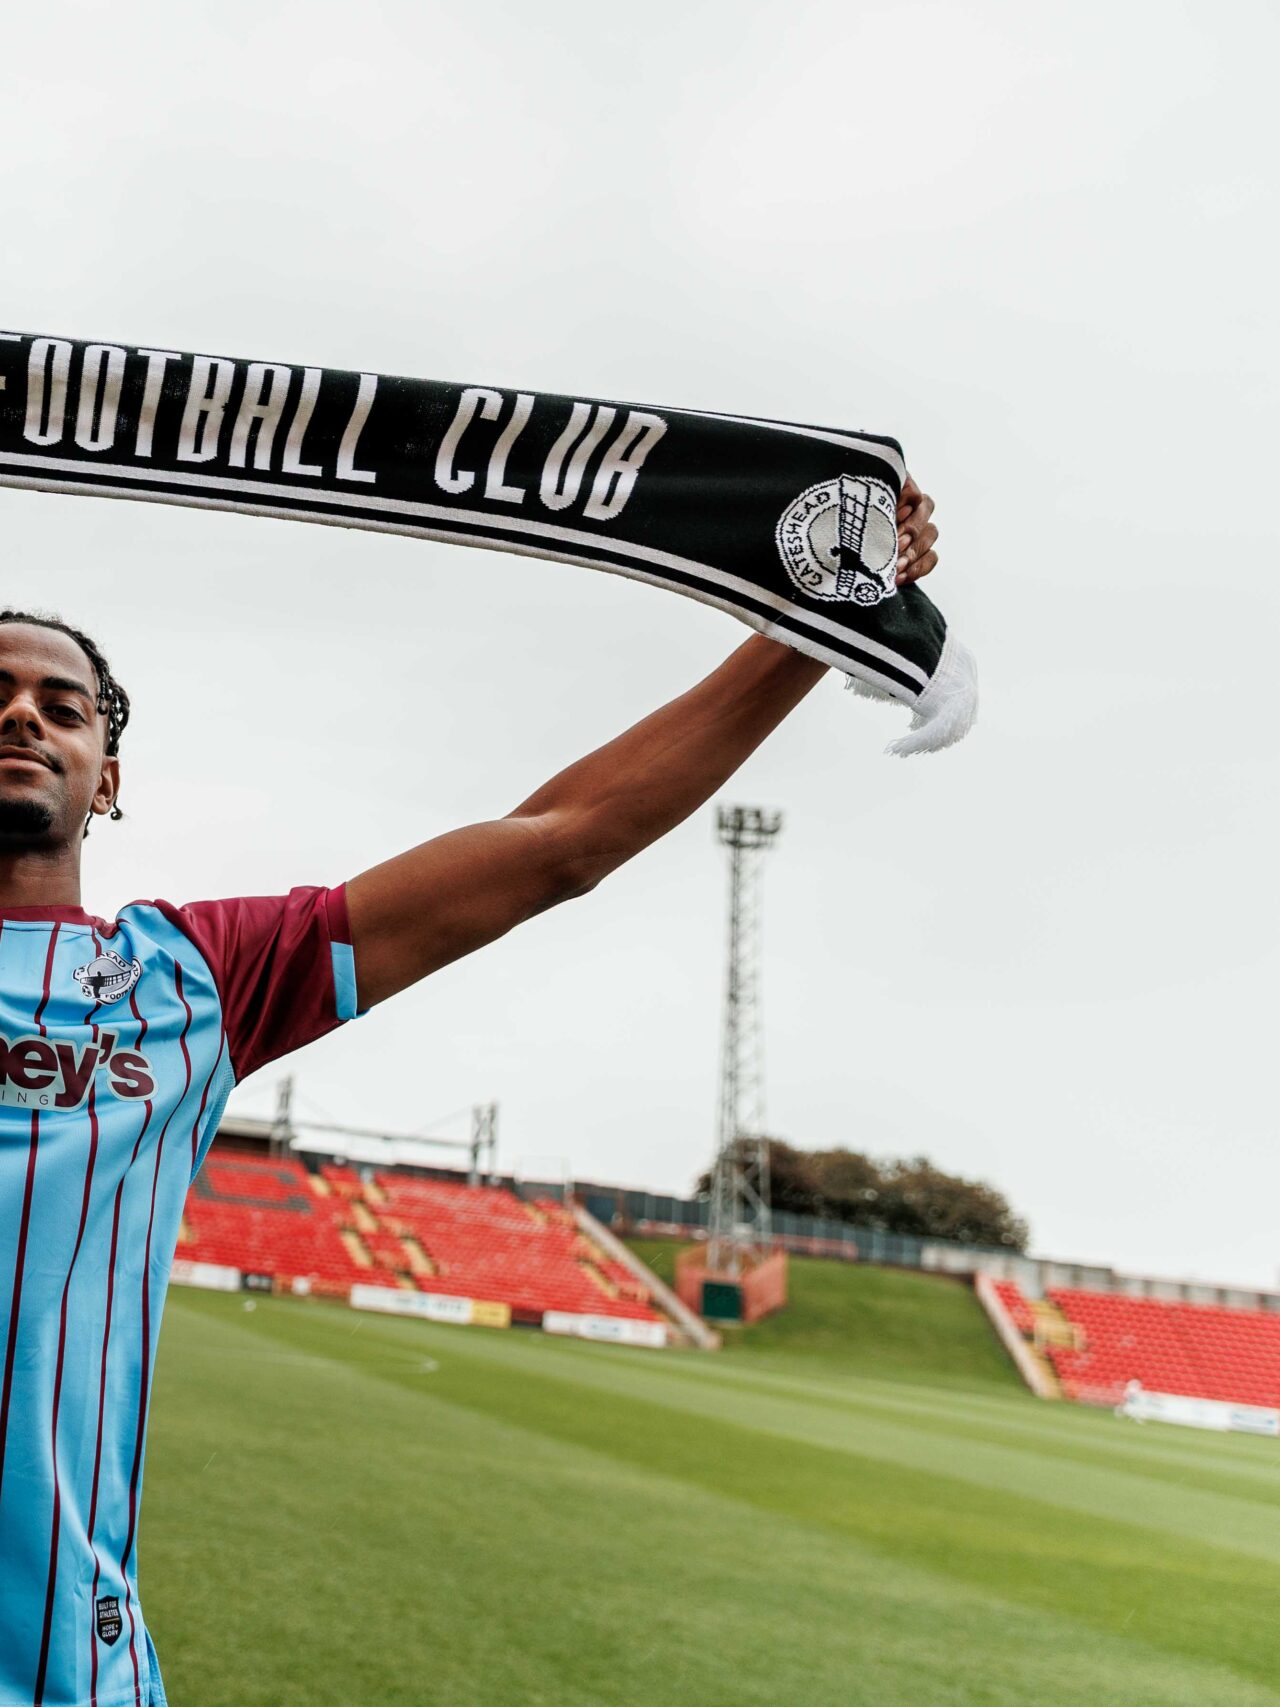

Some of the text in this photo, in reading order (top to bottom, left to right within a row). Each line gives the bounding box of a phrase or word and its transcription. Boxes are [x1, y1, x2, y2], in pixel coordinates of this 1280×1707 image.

[433, 387, 669, 521] CLUB
[785, 491, 831, 586] GATESHEAD
[102, 1630, 118, 1638] GLORY
